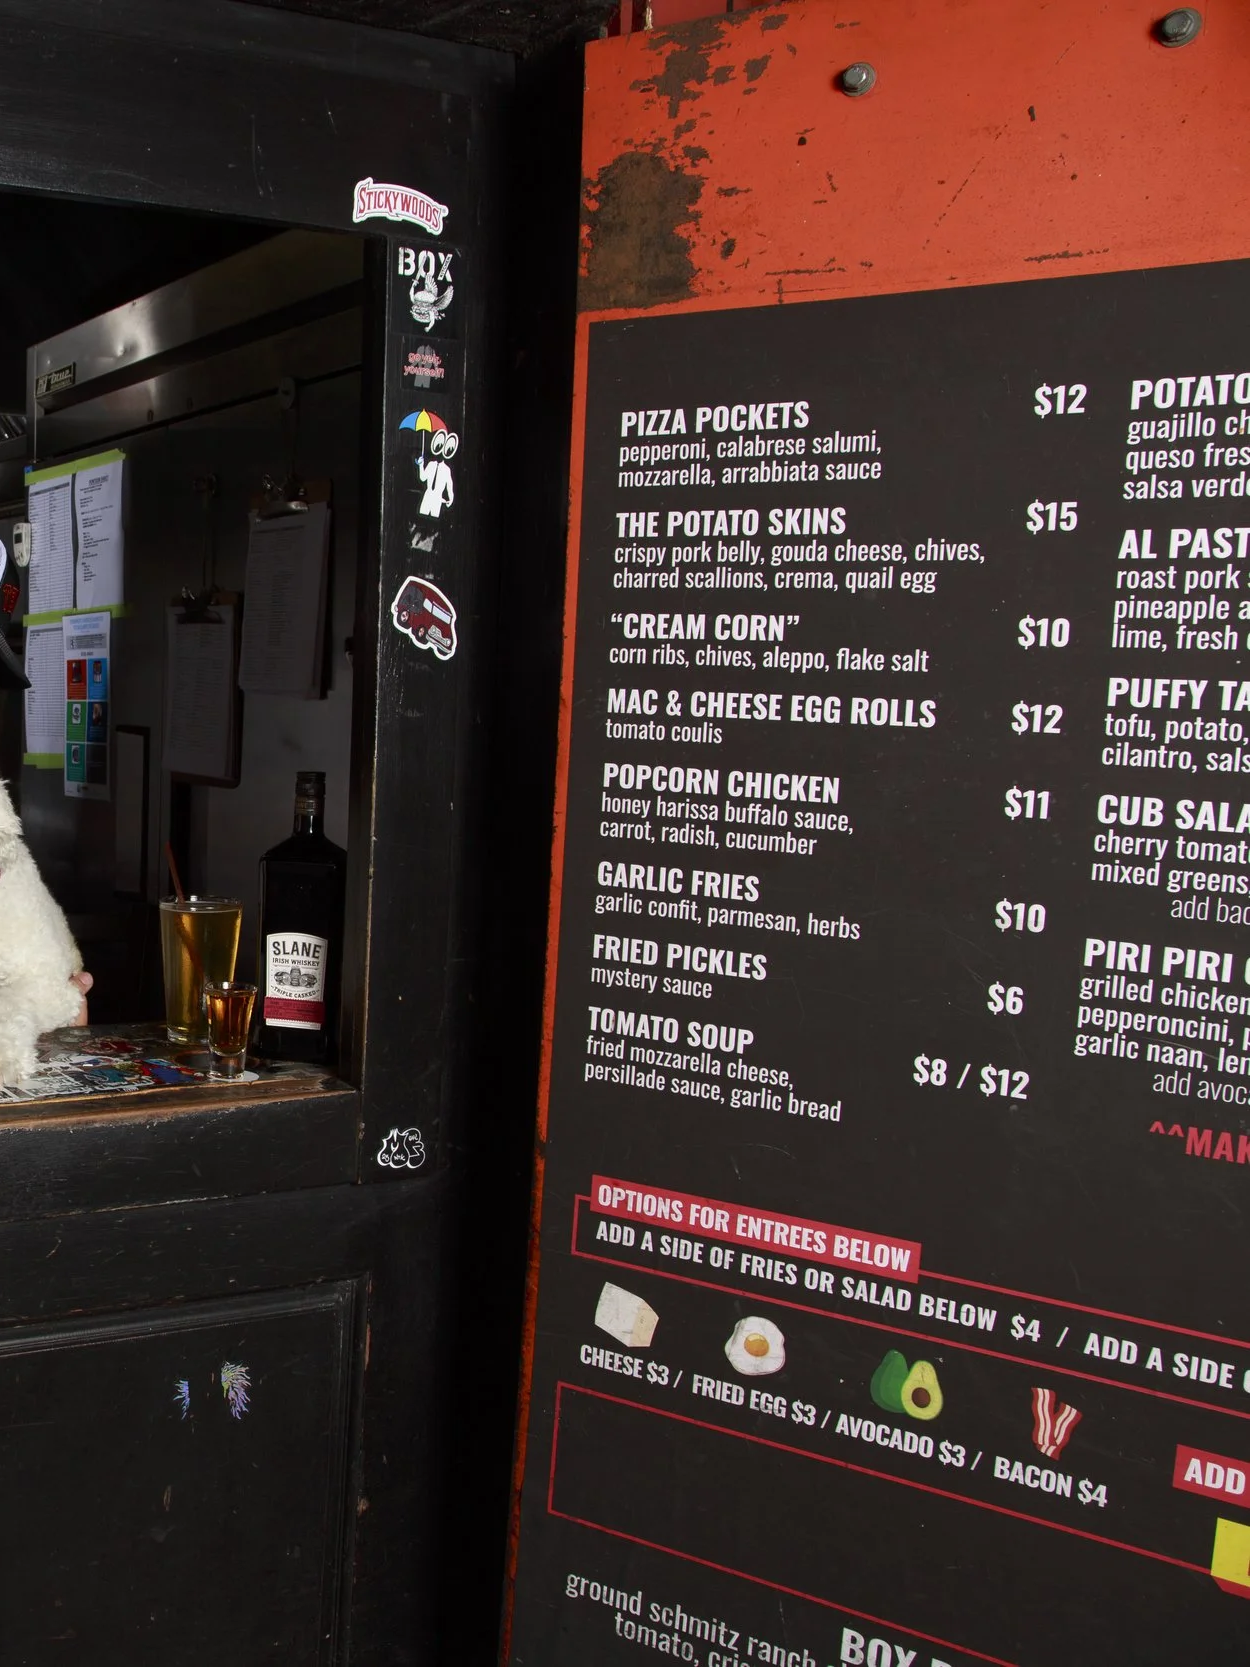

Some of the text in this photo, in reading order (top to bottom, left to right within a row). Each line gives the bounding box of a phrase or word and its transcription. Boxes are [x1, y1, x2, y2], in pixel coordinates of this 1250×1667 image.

[398, 246, 453, 282] BOX
[1034, 383, 1087, 419] $12
[1130, 372, 1250, 410] POTATO
[621, 401, 809, 437] PIZZA POCKETS
[1126, 411, 1216, 445] guajillo
[619, 430, 881, 467] pepperoni, calabrese salumi,
[1125, 449, 1195, 475] queso
[618, 460, 881, 487] mozzarella, arrabbiata sauce
[1122, 474, 1183, 500] salsa
[616, 507, 846, 538] THE POTATO SKINS
[1026, 499, 1077, 535] $15
[614, 538, 985, 567] crispy pork belly, gouda cheese, chives,
[1118, 529, 1157, 559] AL
[613, 566, 938, 593] charred scallions, crema, quail egg
[1116, 566, 1177, 589] roast
[1184, 563, 1241, 594] pork
[1112, 594, 1231, 624] pineapple
[1018, 614, 1070, 650] $10
[1112, 622, 1238, 653] lime, fresh
[609, 643, 929, 673] corn ribs, chives, aleppo, flake salt
[607, 688, 936, 728] MAC & CHEESE EGG ROLLS
[1107, 677, 1208, 710] PUFFY
[605, 719, 722, 744] tomato coulis
[1011, 700, 1063, 736] $12
[1104, 713, 1249, 746] tofu, potato,
[1102, 742, 1197, 773] cilantro,
[603, 763, 840, 804] POPCORN CHICKEN
[601, 791, 853, 835] honey harissa buffalo sauce,
[1004, 785, 1049, 820] $11
[1097, 794, 1163, 827] CUB
[600, 821, 817, 855] carrot, radish, cucumber
[1094, 829, 1169, 861] cherry
[597, 861, 759, 902] GARLIC FRIES
[1091, 859, 1250, 895] mixed greens
[595, 892, 860, 940] garlic confit, parmesan, herbs
[995, 898, 1046, 933] $10
[1170, 895, 1210, 920] add
[272, 941, 322, 959] SLANE
[272, 957, 320, 967] IRISH WHISKEY
[593, 934, 767, 980] FRIED PICKLES
[1084, 938, 1151, 973] PIRI
[1162, 946, 1233, 983] PIRI
[273, 986, 317, 999] TRIPLE CASKED
[591, 967, 712, 998] mystery sauce
[987, 981, 1023, 1015] $6
[1080, 975, 1154, 1003] grilled
[587, 1006, 754, 1054] TOMATO SOUP
[1077, 1004, 1235, 1046] pepperoncini,
[586, 1035, 793, 1091] fried mozzarella cheese,
[1073, 1032, 1208, 1072] garlic naan,
[584, 1063, 841, 1122] persillade sauce, garlic bread
[913, 1053, 1029, 1100] $8 $12
[1153, 1070, 1191, 1096] add
[598, 1184, 911, 1272] OPTIONS FOR ENTREES BELOW
[596, 1221, 635, 1246] ADD
[640, 1231, 653, 1252] A
[660, 1235, 704, 1263] SIDE
[710, 1246, 735, 1270] OF
[740, 1253, 797, 1285] FRIES
[804, 1268, 834, 1294] OR
[841, 1276, 911, 1311] SALAD
[919, 1294, 997, 1331] BELOW
[1010, 1313, 1040, 1342] $4
[1083, 1332, 1138, 1364] ADD
[1145, 1347, 1163, 1372] A
[1172, 1353, 1235, 1389] SIDE
[580, 1344, 1107, 1507] CHEESE $3 FRIED EGG $3 AVOCADO $3 BACON $4
[1184, 1458, 1246, 1495] ADD
[566, 1574, 815, 1667] ground schmitz ranch
[615, 1612, 700, 1667] tomato,
